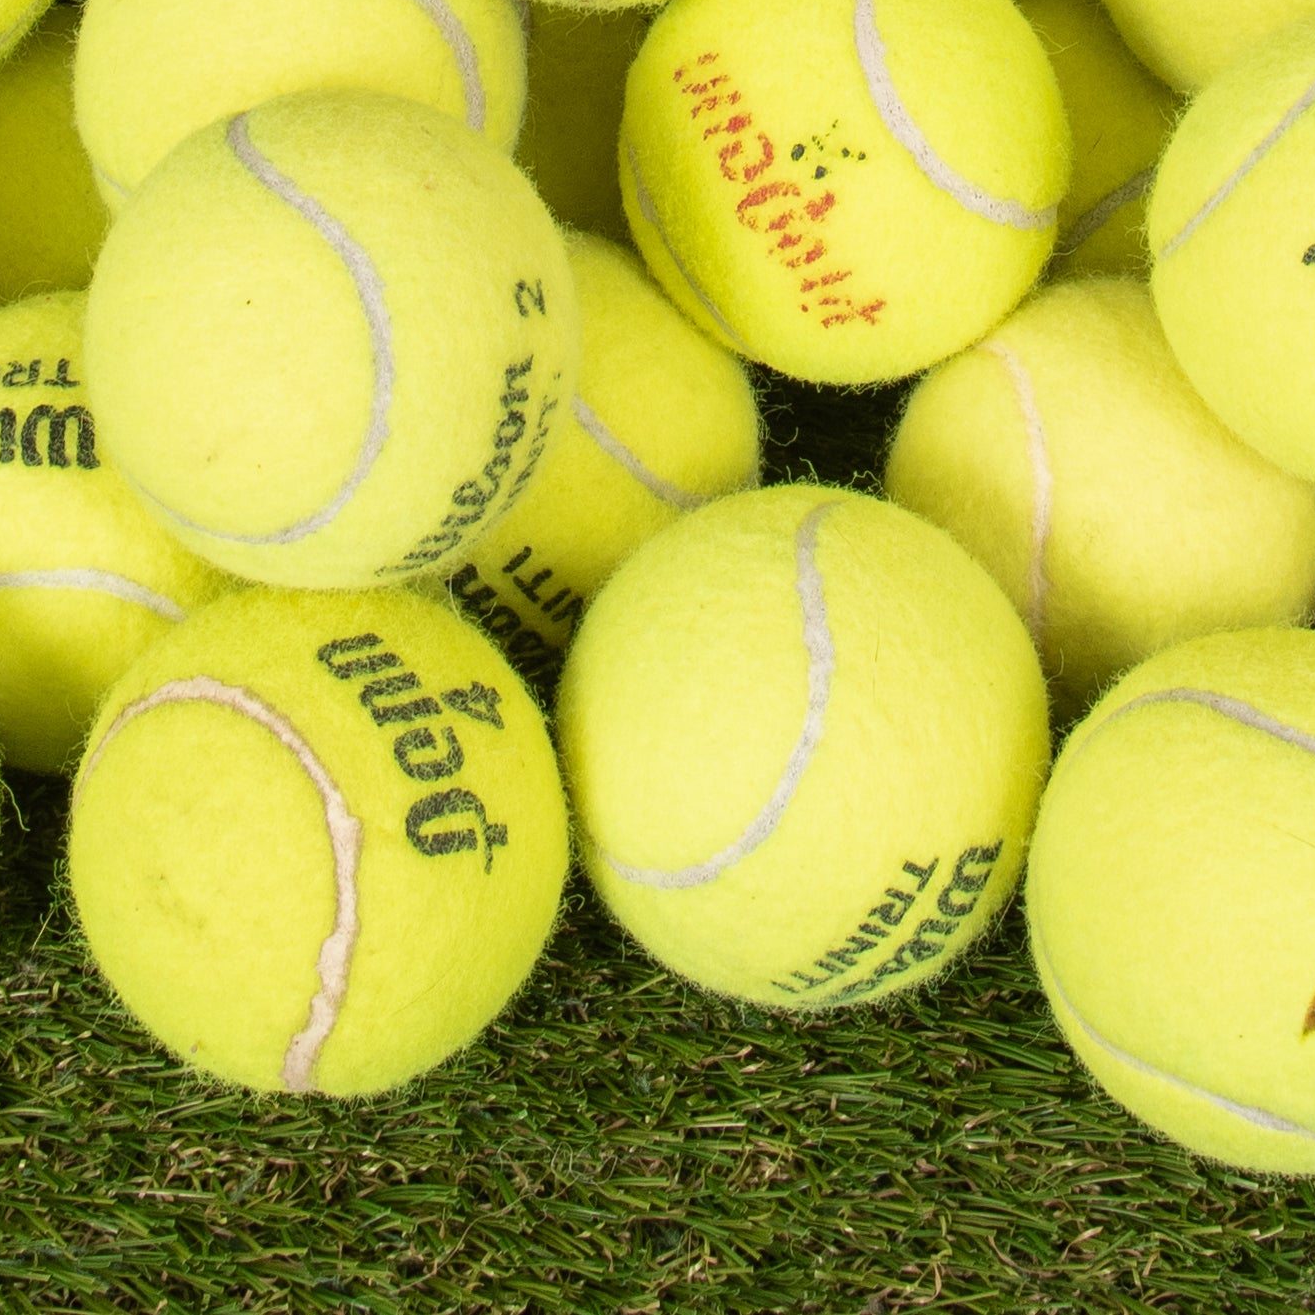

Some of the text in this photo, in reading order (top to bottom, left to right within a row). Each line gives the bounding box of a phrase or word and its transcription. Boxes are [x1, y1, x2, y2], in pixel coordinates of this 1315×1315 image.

[514, 279, 547, 318] 2
[439, 680, 505, 731] 4
[770, 856, 940, 994] TRINITI
